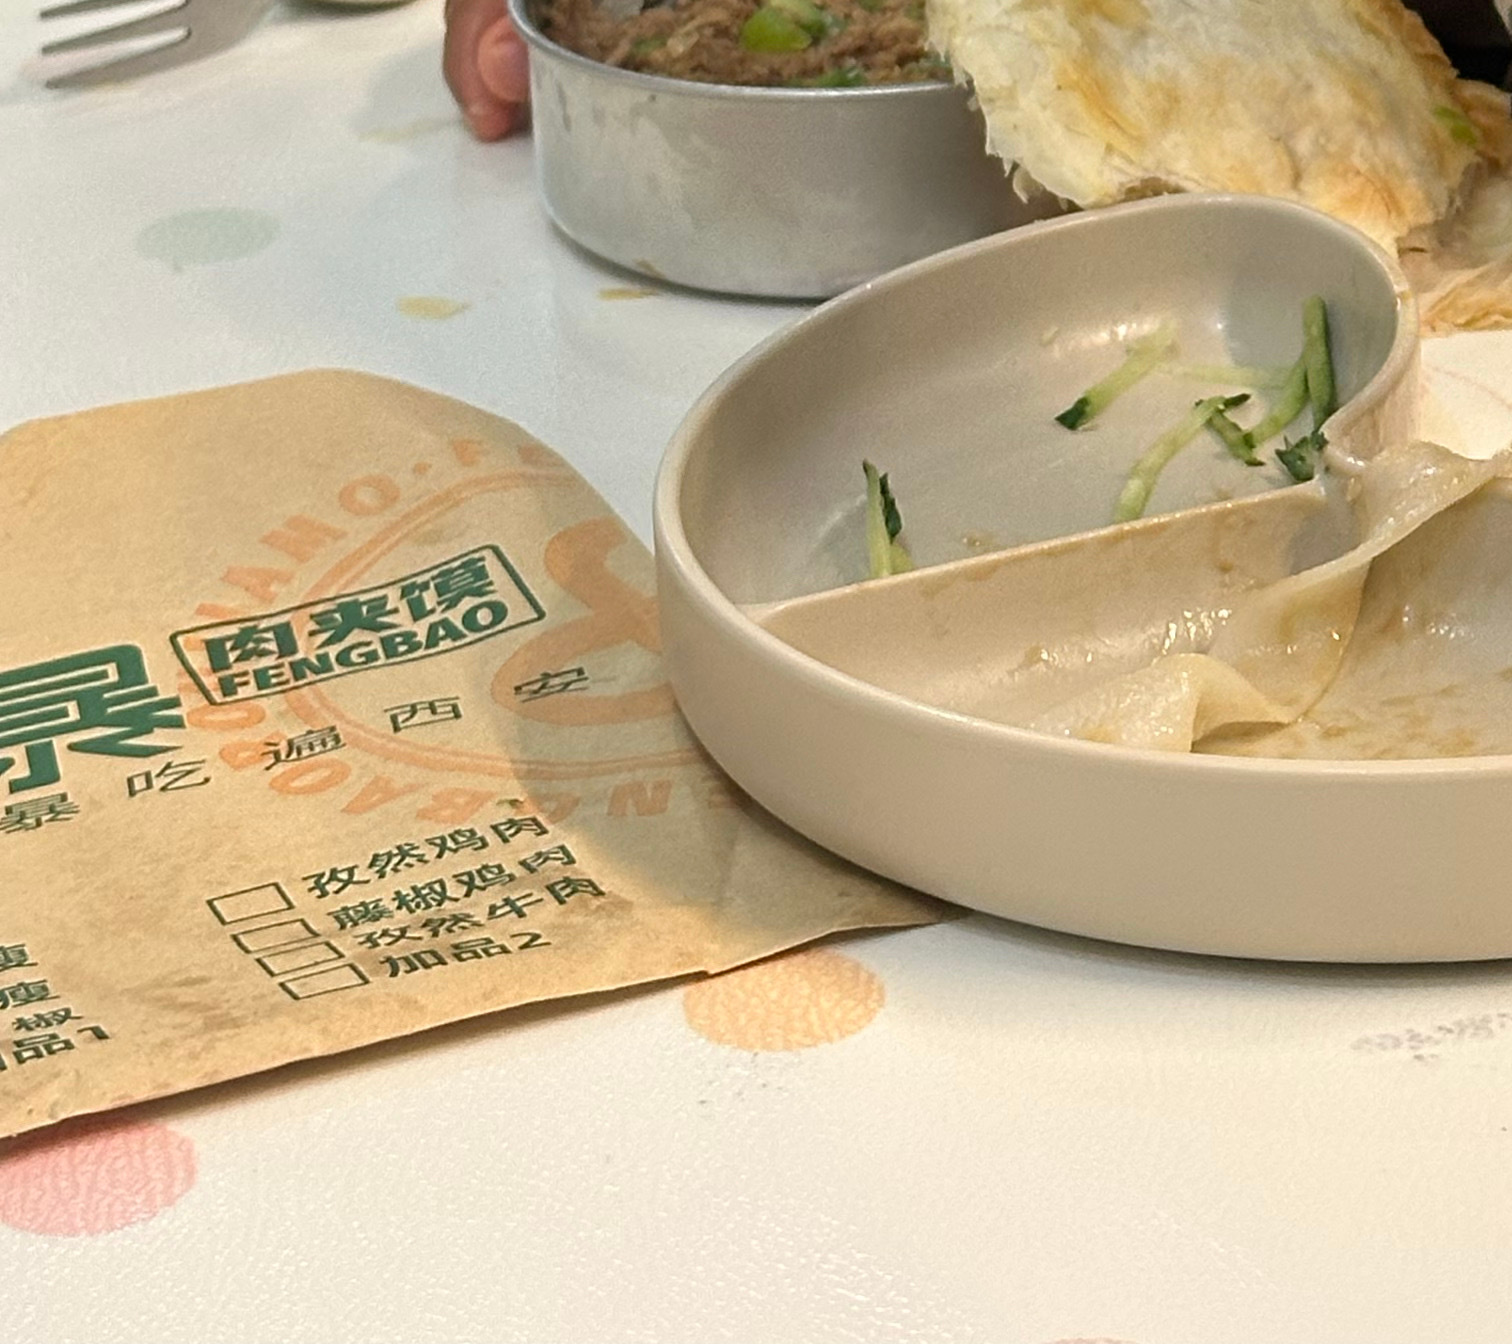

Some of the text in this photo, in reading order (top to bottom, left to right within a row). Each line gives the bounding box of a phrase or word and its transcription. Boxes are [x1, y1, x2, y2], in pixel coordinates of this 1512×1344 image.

[203, 553, 498, 674] 肉夹馍
[217, 599, 509, 698] FENGBAO
[302, 815, 550, 899] 孜然鸡肉
[326, 844, 577, 930] 藤椒鸡肉
[353, 875, 606, 949] 孜然牛肉
[380, 931, 552, 978] 加品2
[0, 1025, 110, 1071] 品1
